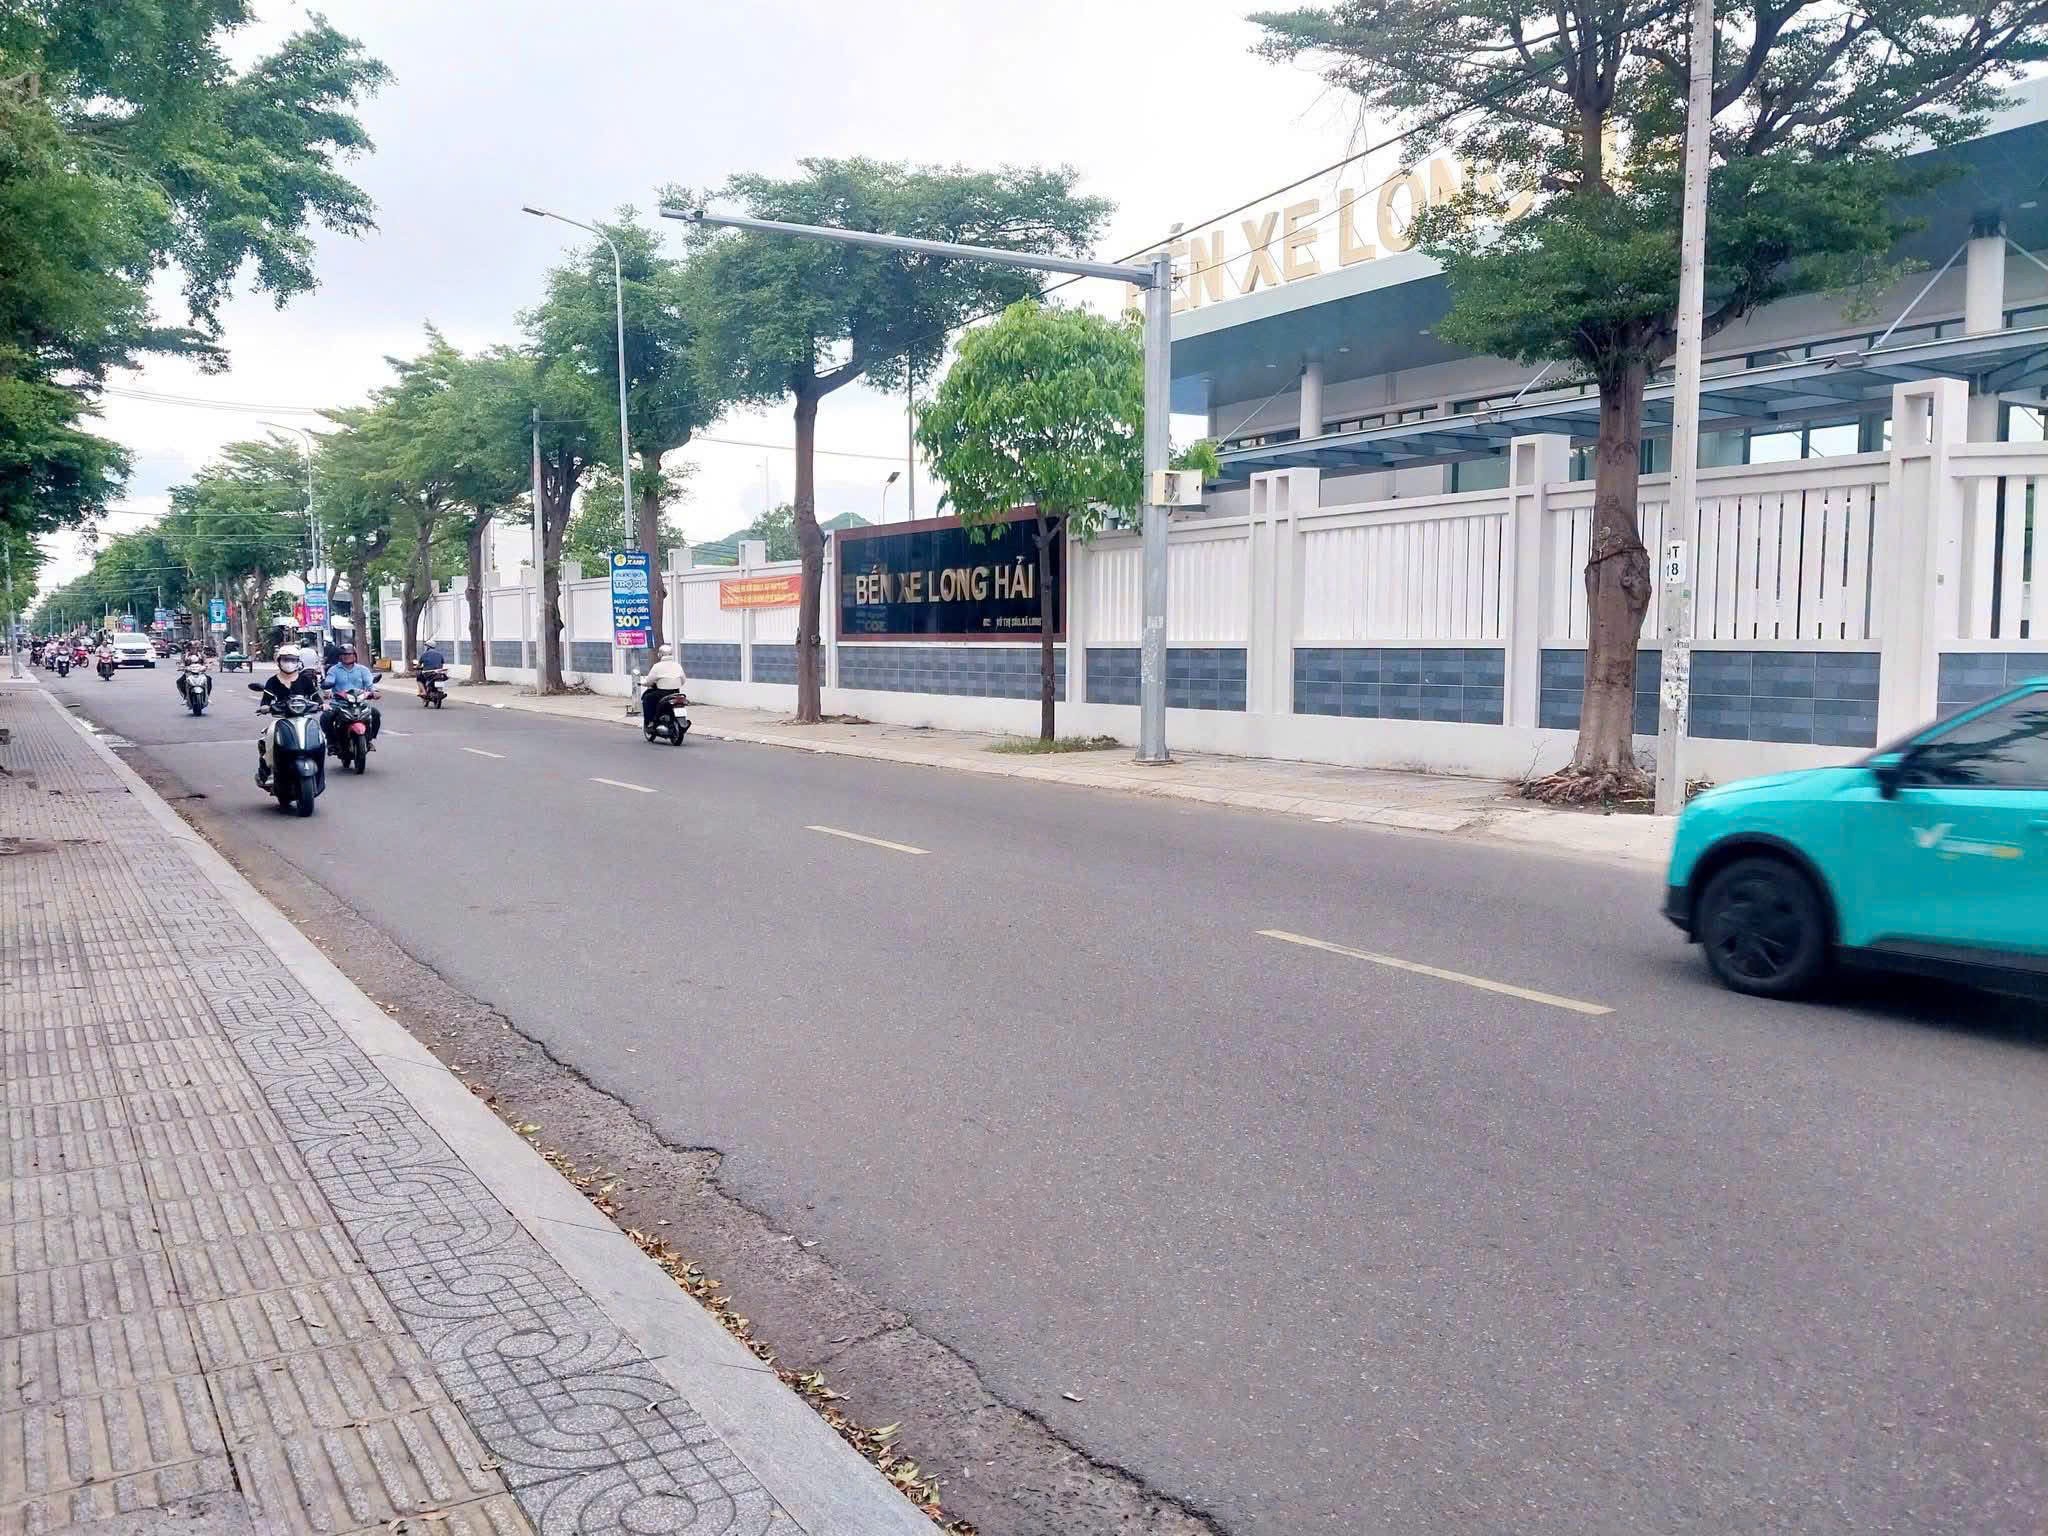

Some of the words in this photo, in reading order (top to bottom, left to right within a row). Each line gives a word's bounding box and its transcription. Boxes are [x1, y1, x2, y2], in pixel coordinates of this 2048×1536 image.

[1240, 198, 1321, 294] XE
[856, 564, 893, 605] BẾN
[897, 571, 922, 603] XE
[928, 566, 989, 602] LONG
[994, 555, 1034, 600] HẢI
[615, 615, 640, 627] 300
